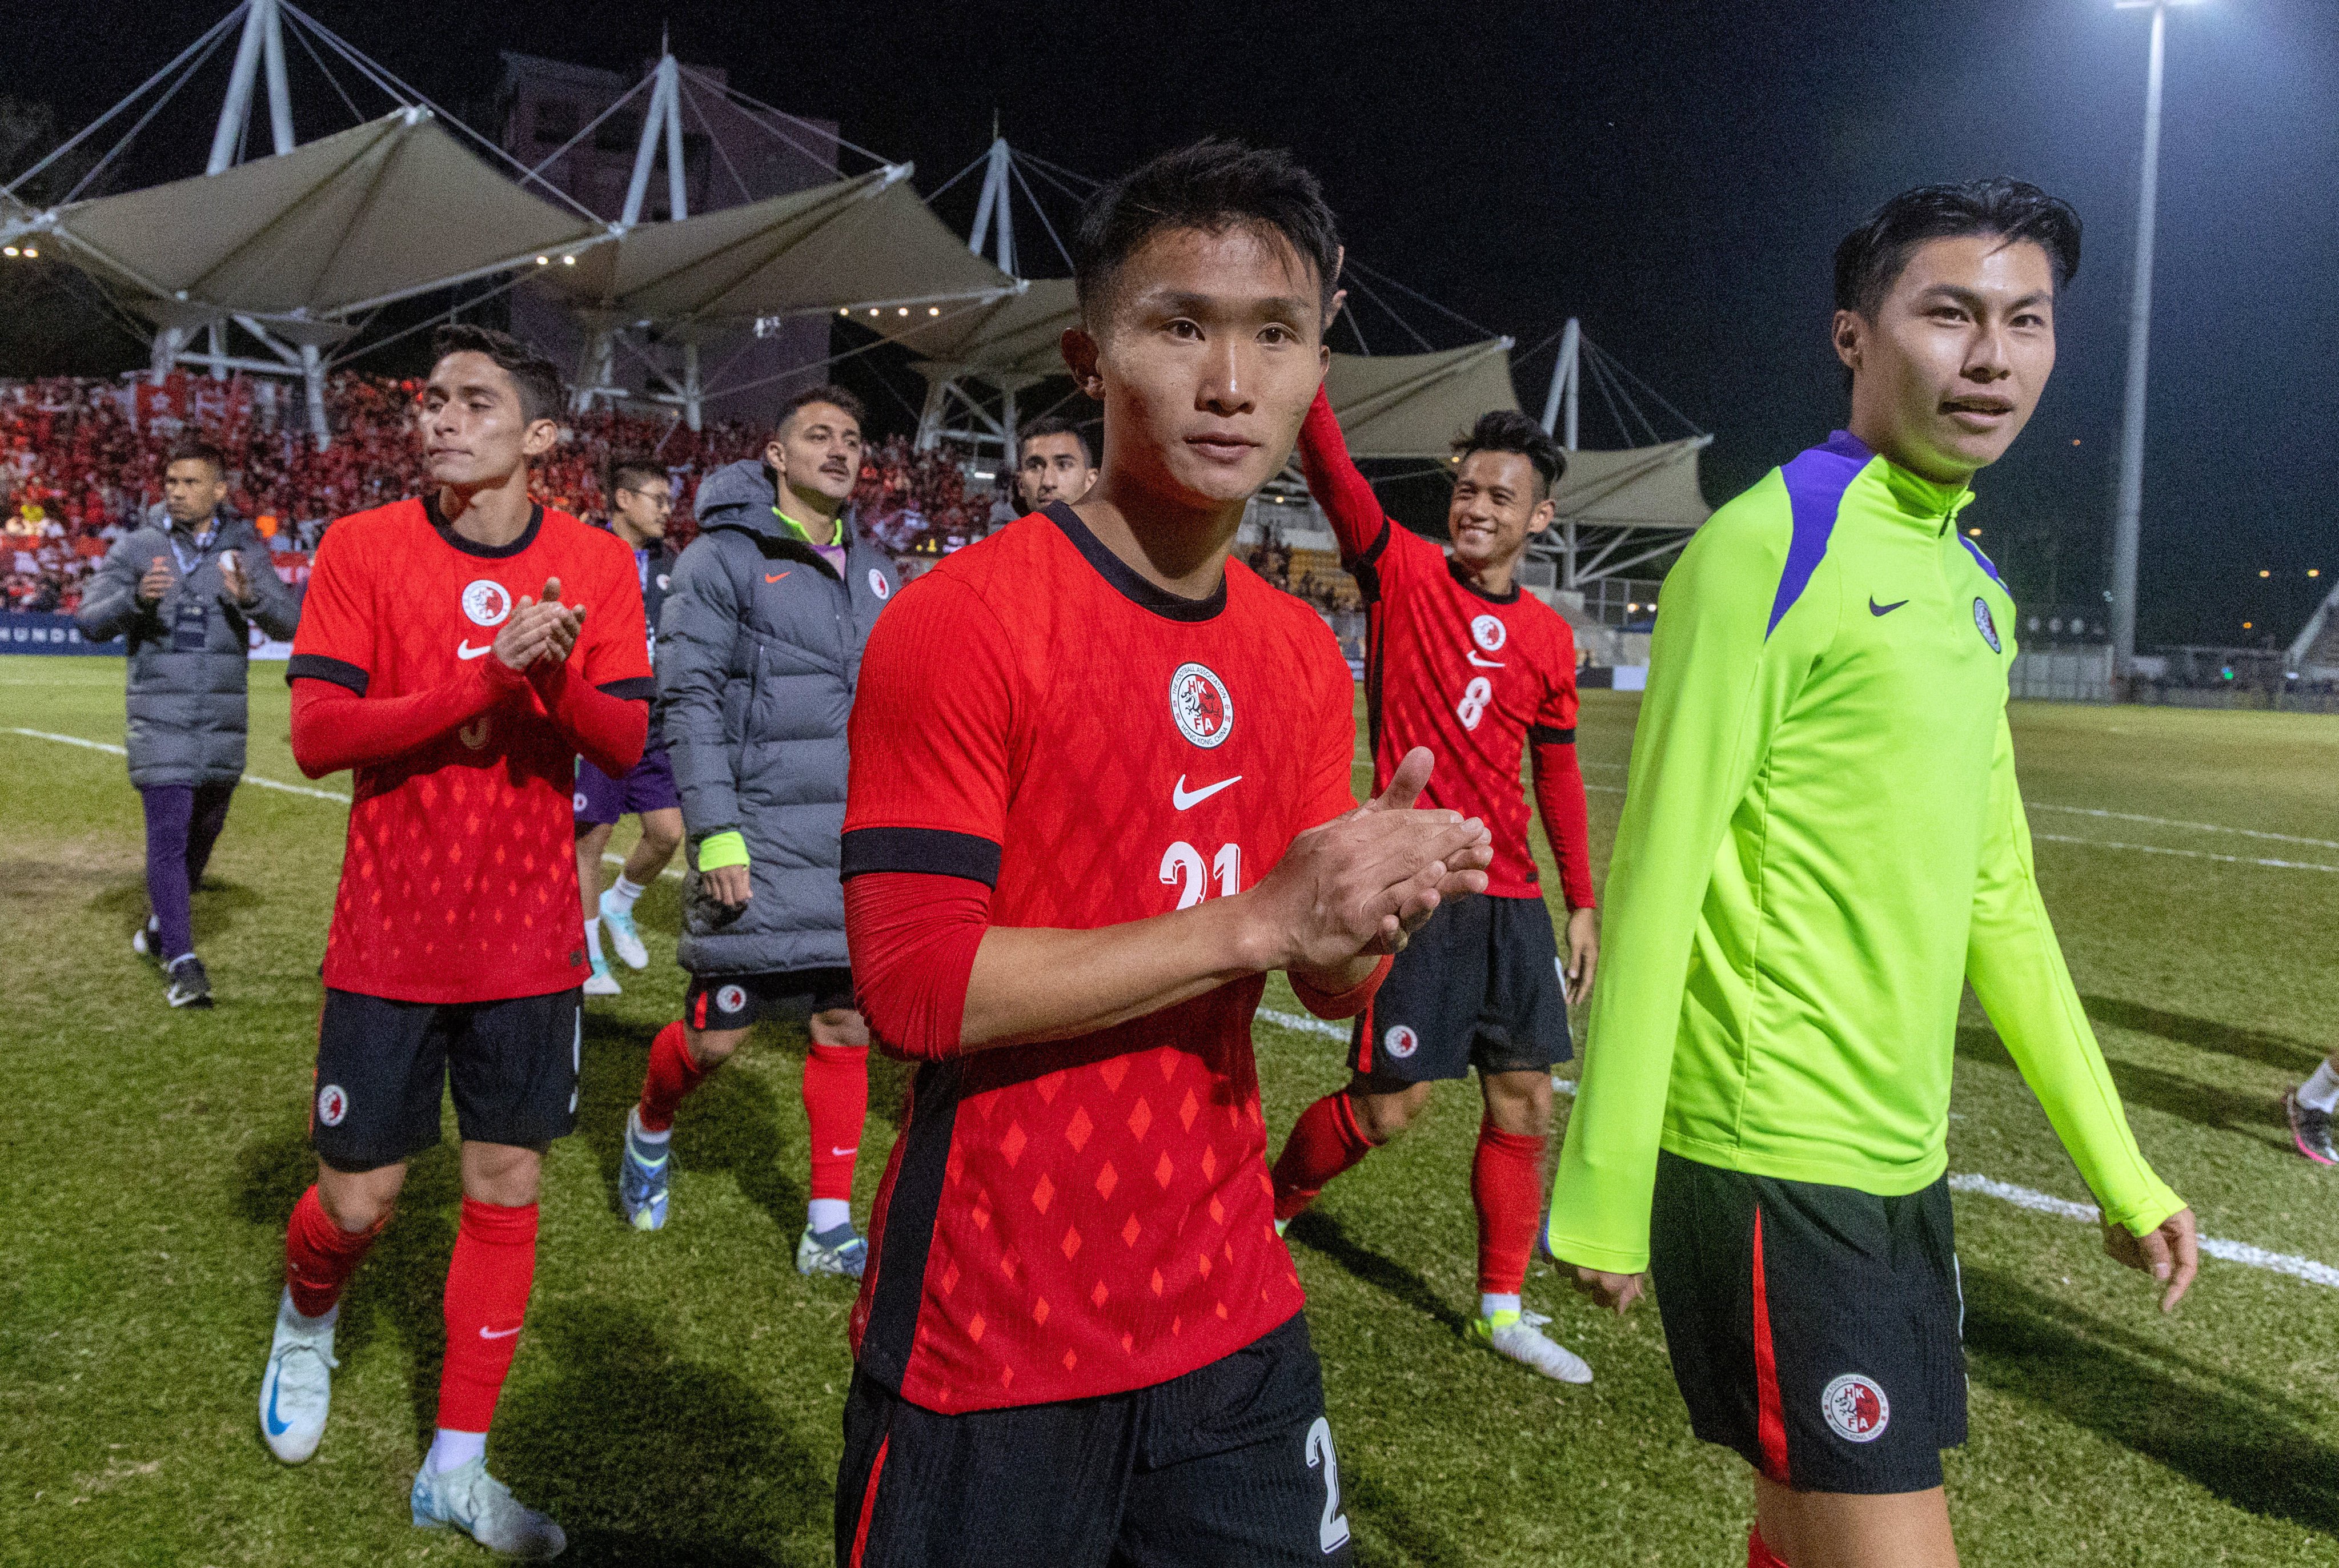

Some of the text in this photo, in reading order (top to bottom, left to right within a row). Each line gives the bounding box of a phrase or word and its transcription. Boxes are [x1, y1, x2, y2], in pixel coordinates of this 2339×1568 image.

[1177, 666, 1195, 683] FOOTBALL
[1196, 666, 1227, 699] ASSOCIATION
[1187, 680, 1207, 694] HK
[1457, 676, 1493, 731] 8
[1193, 717, 1214, 731] FA
[1181, 725, 1197, 742] HONG
[1214, 727, 1228, 742] CHINA
[1159, 841, 1241, 911] 21
[1844, 1388, 1865, 1399] HK
[1848, 1417, 1869, 1429] FA
[1306, 1417, 1351, 1555] 2
